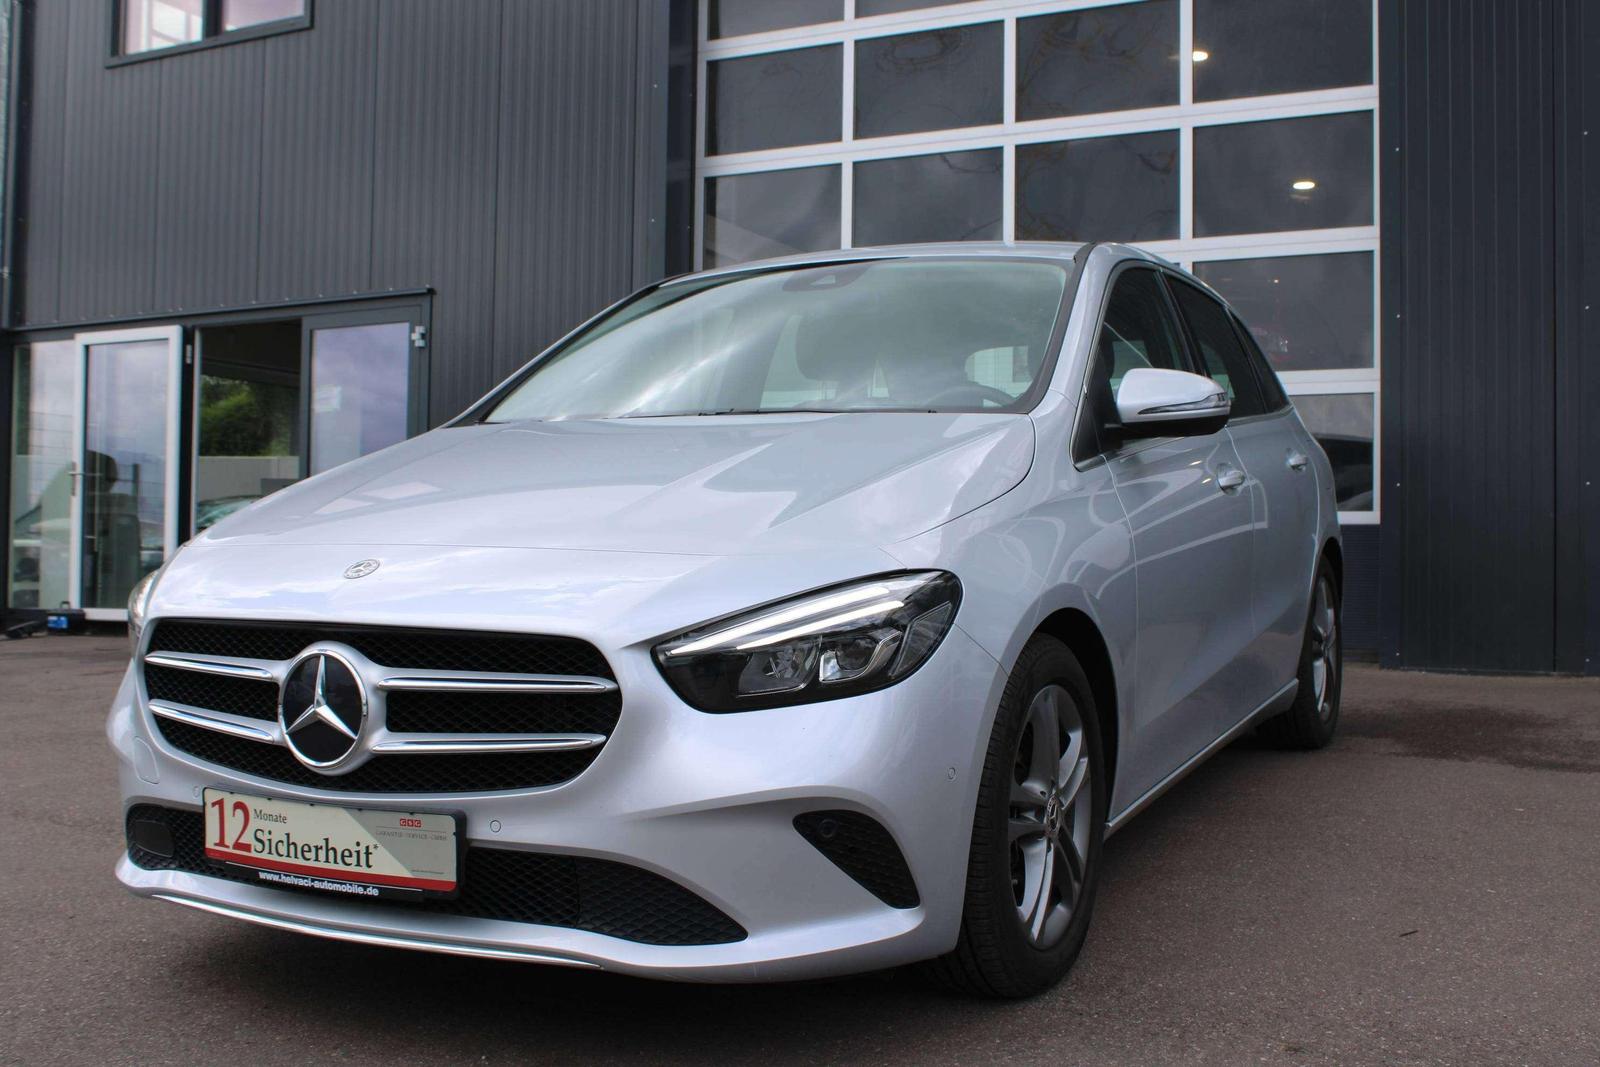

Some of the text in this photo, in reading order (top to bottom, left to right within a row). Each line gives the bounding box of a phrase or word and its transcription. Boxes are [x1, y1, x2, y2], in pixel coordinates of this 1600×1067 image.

[210, 798, 288, 854] 12 Monate
[399, 818, 422, 828] GSG
